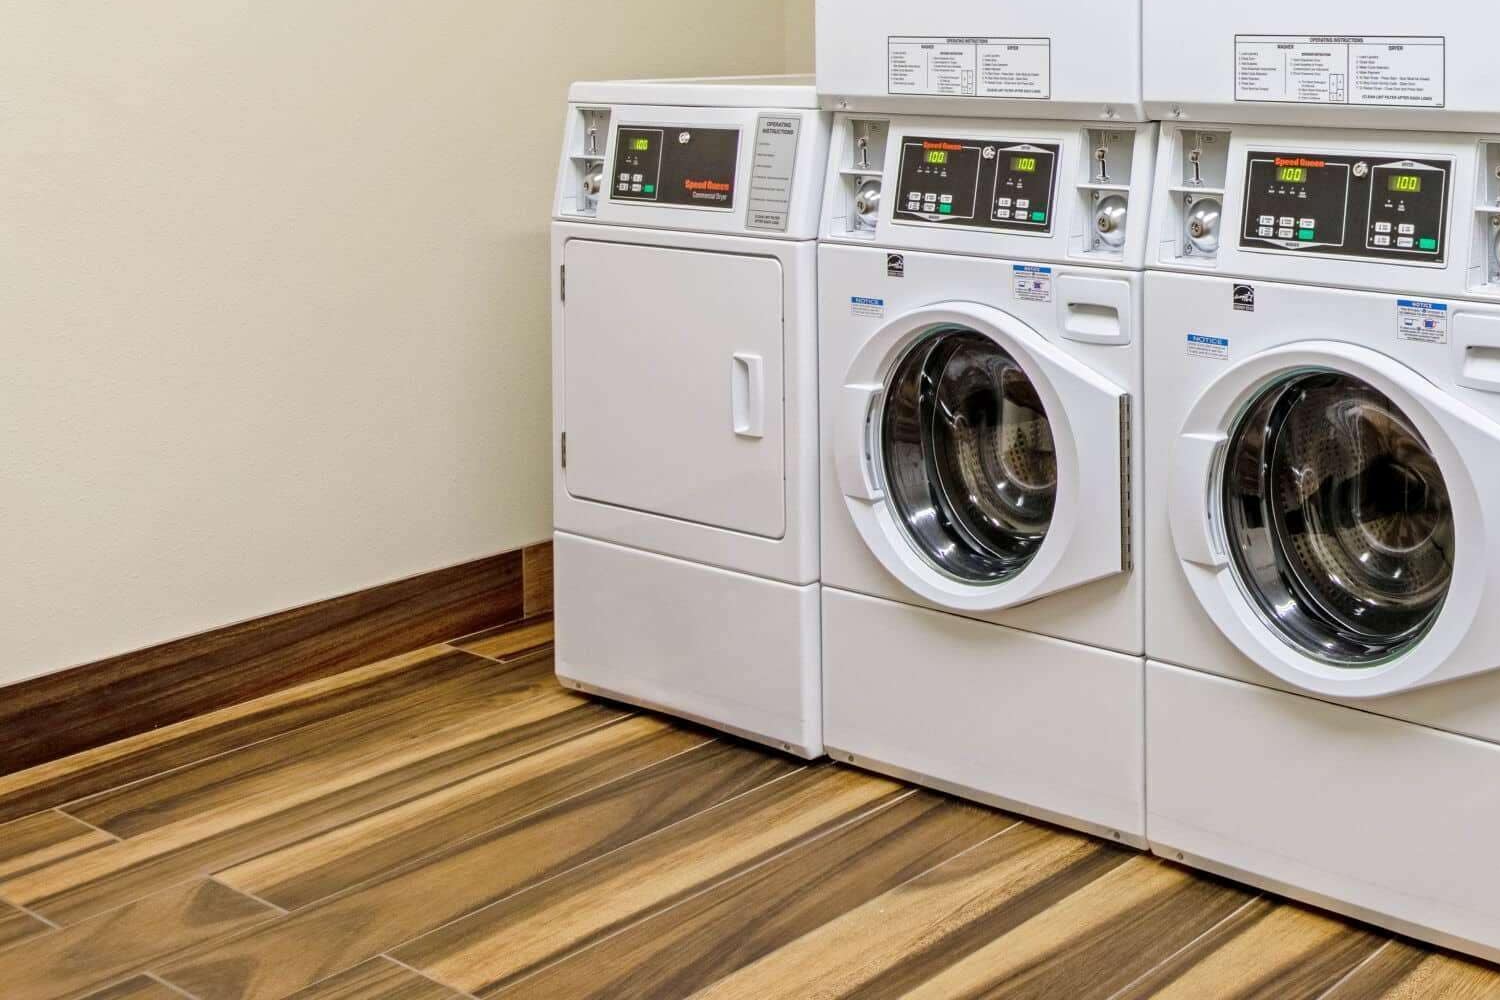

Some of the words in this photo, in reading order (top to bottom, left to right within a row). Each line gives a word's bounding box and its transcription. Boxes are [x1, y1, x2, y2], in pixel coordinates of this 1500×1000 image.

[928, 151, 944, 163] 100
[1274, 157, 1299, 168] Speed
[1300, 158, 1325, 168] Queen
[1017, 158, 1036, 171] 100
[1281, 167, 1301, 182] 100
[685, 179, 707, 191] Speed
[1396, 175, 1418, 190] 100
